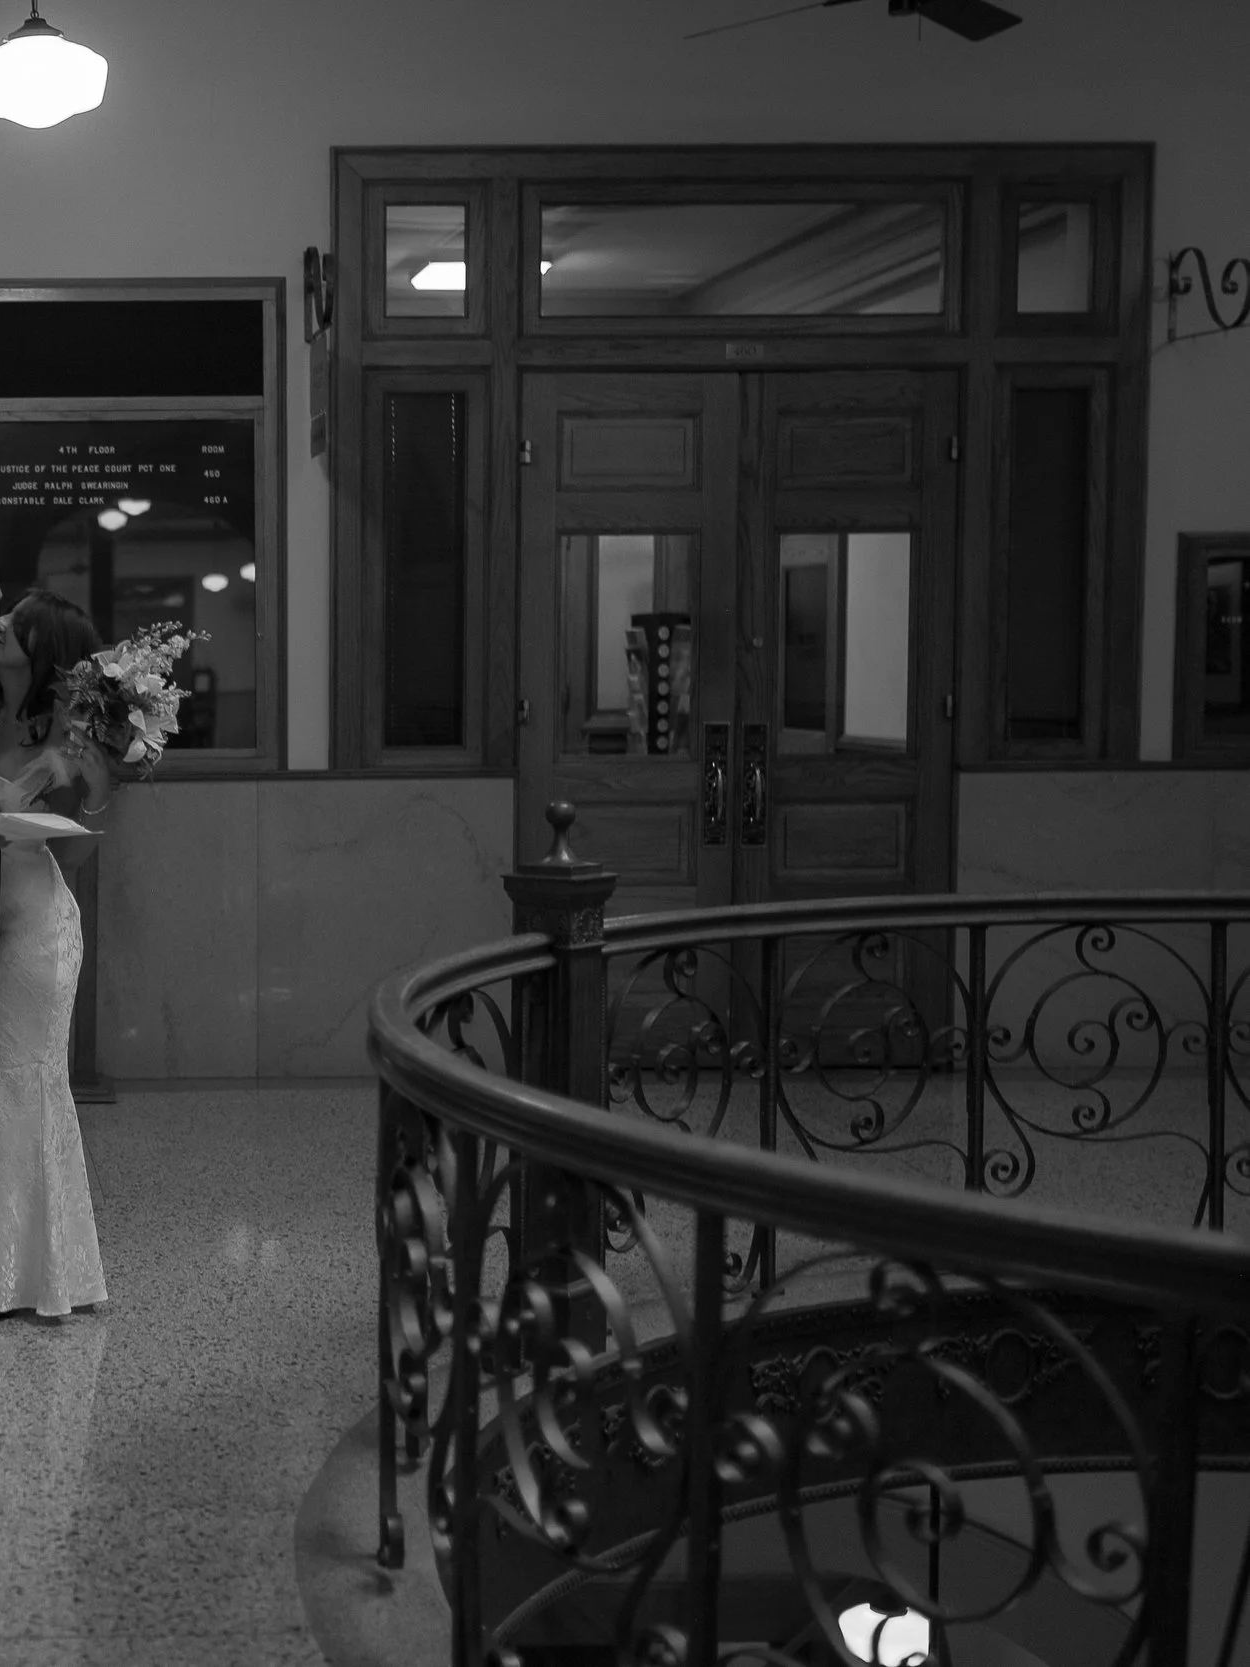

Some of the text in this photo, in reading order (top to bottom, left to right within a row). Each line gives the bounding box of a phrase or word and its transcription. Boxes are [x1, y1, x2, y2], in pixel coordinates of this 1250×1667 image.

[59, 445, 116, 455] 4TH FLOOR
[201, 445, 225, 454] ROOM
[34, 464, 46, 473] OF
[51, 464, 68, 474] THE
[71, 464, 100, 473] PEACE
[104, 464, 132, 473] COURT
[138, 464, 153, 473] PCT
[159, 464, 176, 473] ONE
[12, 481, 38, 490] JUDGE
[44, 481, 73, 490] RALPH
[53, 496, 73, 505] DALE
[78, 496, 104, 505] CLARK
